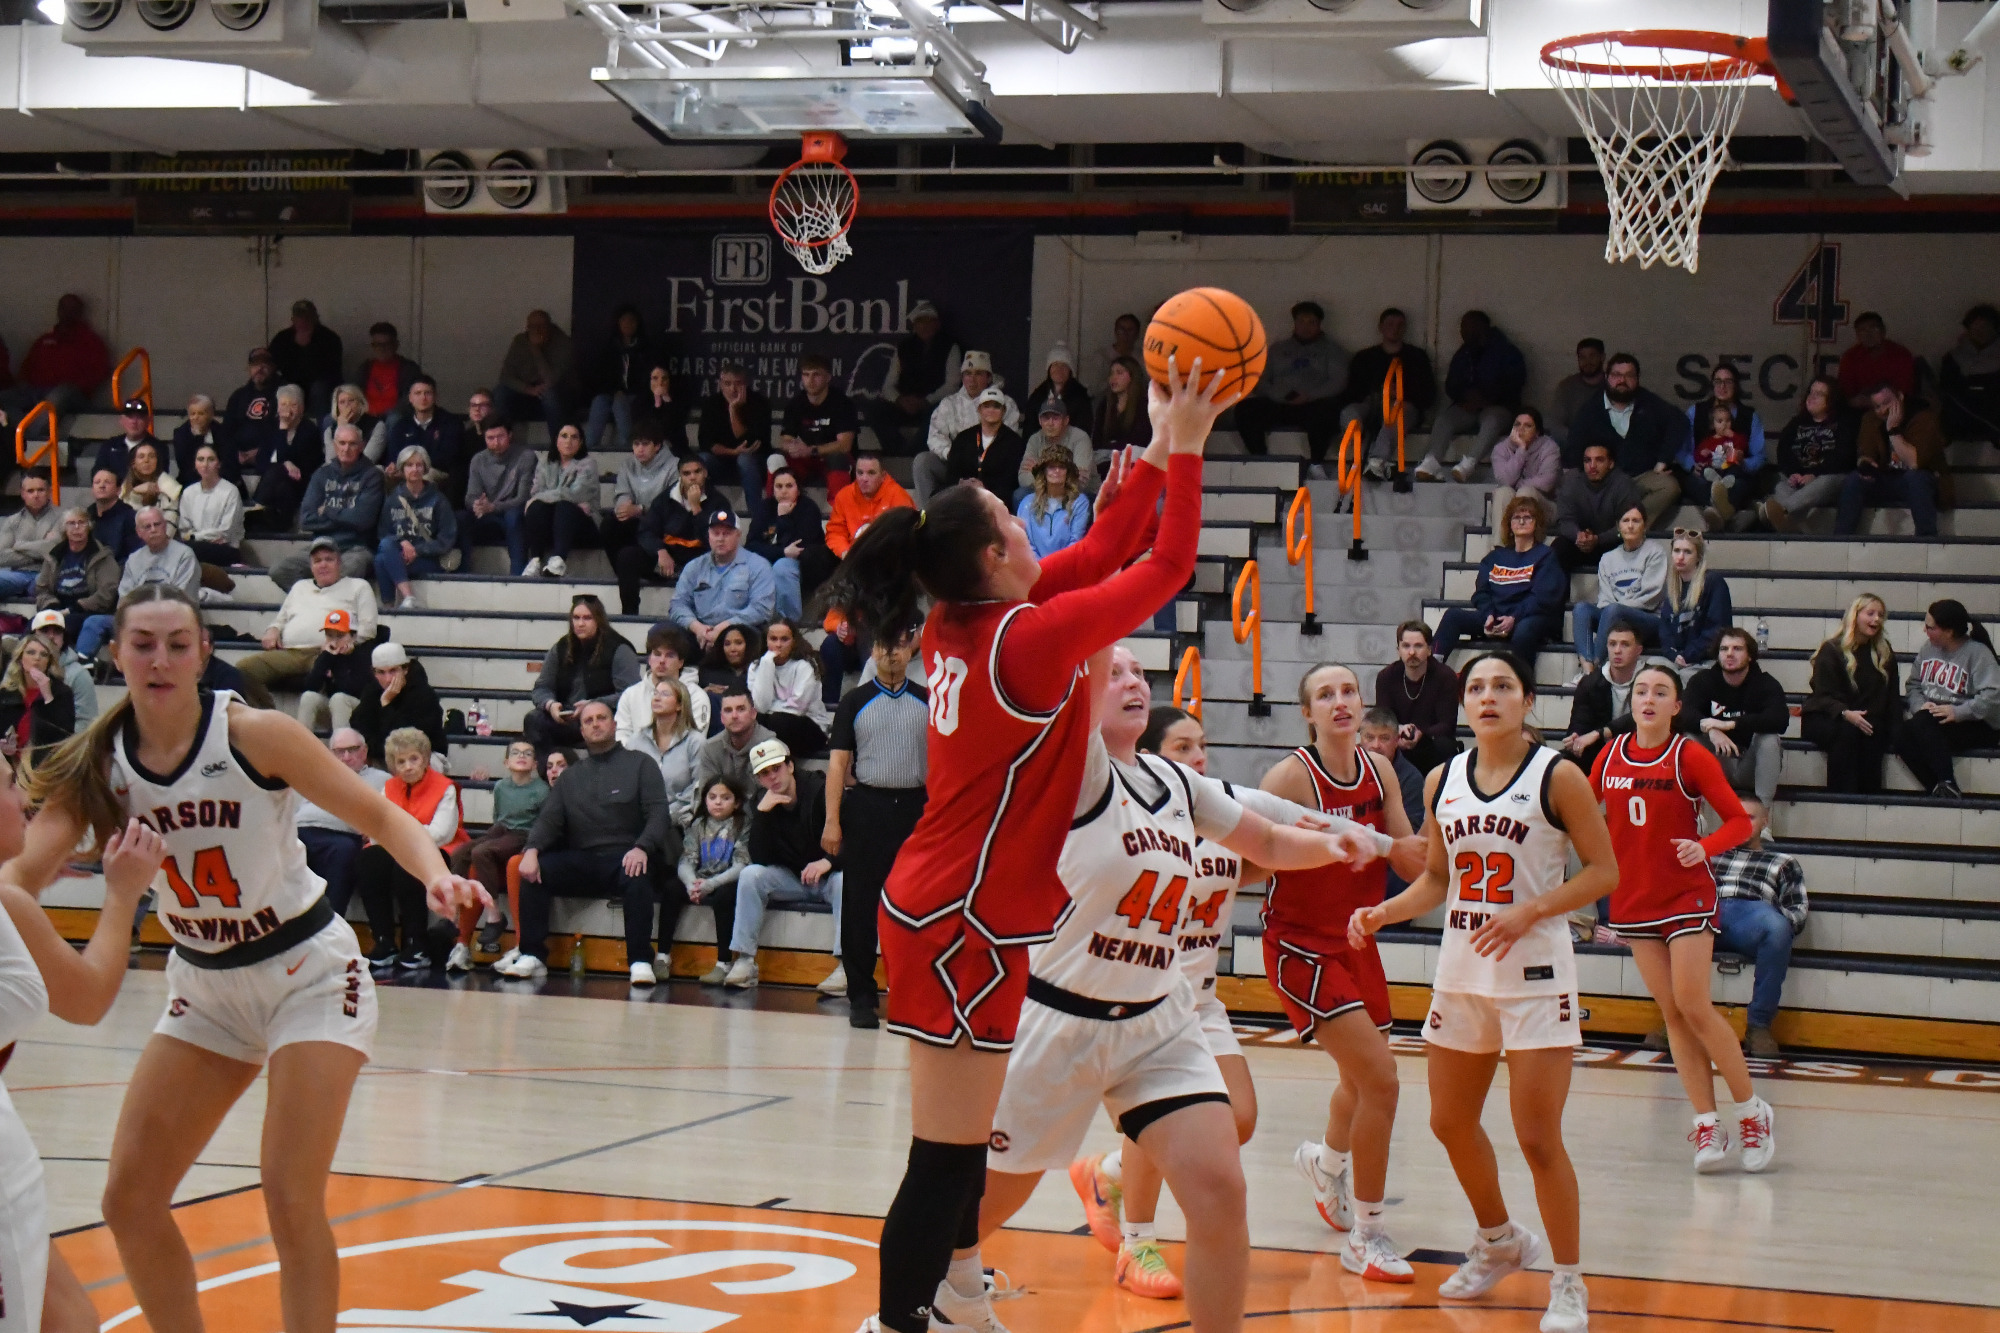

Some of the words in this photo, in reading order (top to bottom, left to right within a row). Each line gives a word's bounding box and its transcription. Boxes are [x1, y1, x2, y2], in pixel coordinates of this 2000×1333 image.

[1363, 203, 1387, 214] SAC
[718, 240, 768, 278] FB
[665, 277, 920, 334] FirstBank
[1773, 243, 1850, 343] 4
[711, 342, 756, 353] OFFICIAL
[760, 342, 787, 353] BANK
[791, 342, 804, 353] OF
[928, 651, 968, 736] 10
[203, 760, 228, 775] SAC
[1512, 793, 1531, 803] SAC
[1628, 796, 1647, 827] 0
[137, 800, 241, 834] ARSON
[1445, 814, 1530, 845] CARSON
[1122, 827, 1193, 866] CARSON
[160, 845, 241, 908] 14
[1455, 851, 1515, 904] 22
[1115, 869, 1189, 935] 44
[166, 906, 282, 943] NEWMAN
